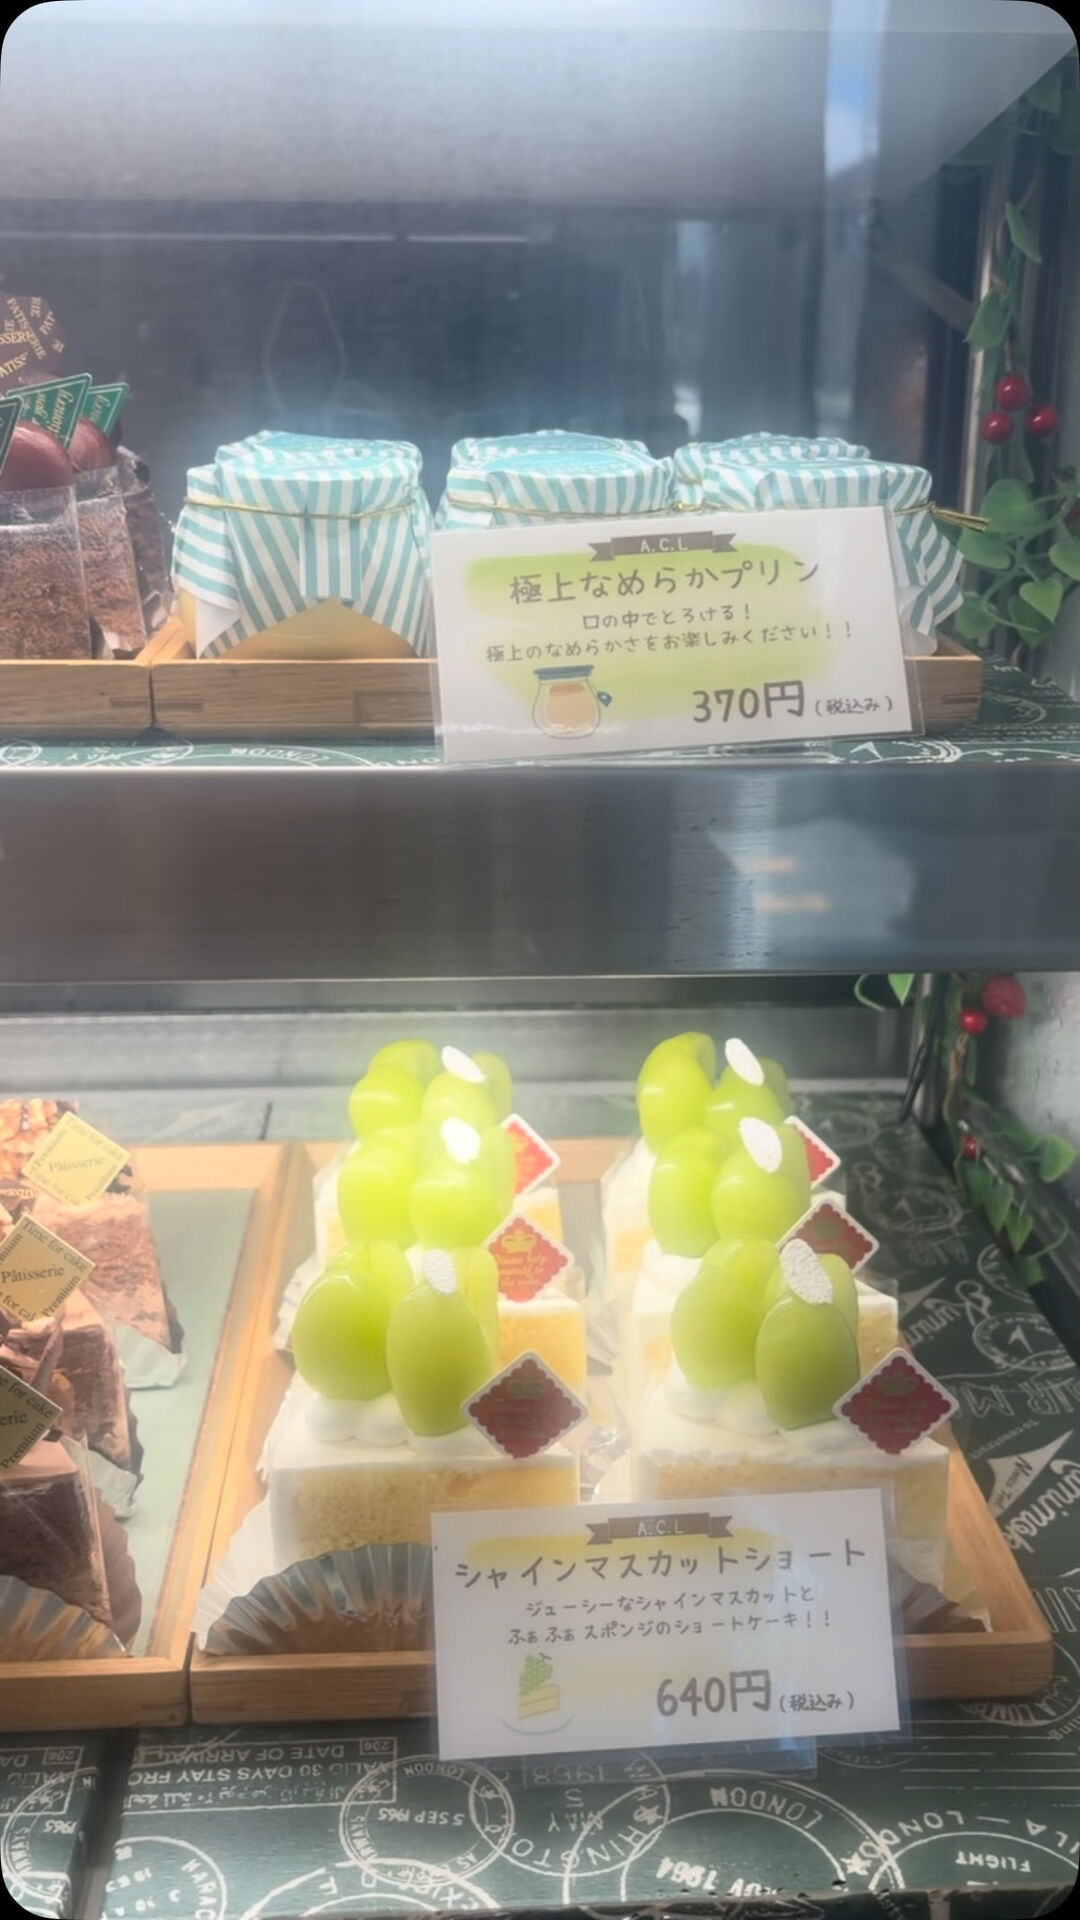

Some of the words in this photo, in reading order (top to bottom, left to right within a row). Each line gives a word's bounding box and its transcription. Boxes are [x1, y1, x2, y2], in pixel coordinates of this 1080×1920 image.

[509, 558, 820, 605] 極上なめらかプリン
[582, 603, 751, 631] 口の中でとろける！
[485, 620, 852, 663] 極上のなめらかさをお楽しみください！！
[692, 680, 805, 725] 370円
[22, 1219, 49, 1243] Time
[48, 1239, 65, 1255] for
[64, 1251, 87, 1273] cake
[1, 1263, 65, 1283] Pâtisserie
[41, 1275, 80, 1317] Premium
[8, 1382, 27, 1400] for
[27, 1396, 54, 1418] cake
[0, 1423, 45, 1469] Premium
[454, 1538, 867, 1589] シャインマスカットショート
[525, 1584, 816, 1617] ジューシーなシャインマスカットと
[657, 1669, 772, 1718] 640円
[255, 1747, 285, 1761] OF
[290, 1745, 345, 1759] DATE
[177, 1768, 230, 1783] STAY
[238, 1765, 292, 1779] DAYS
[300, 1764, 322, 1776] 30
[414, 1809, 450, 1825] SEP
[709, 1786, 824, 1830] LONDON
[955, 1850, 1031, 1873] FLIGHT
